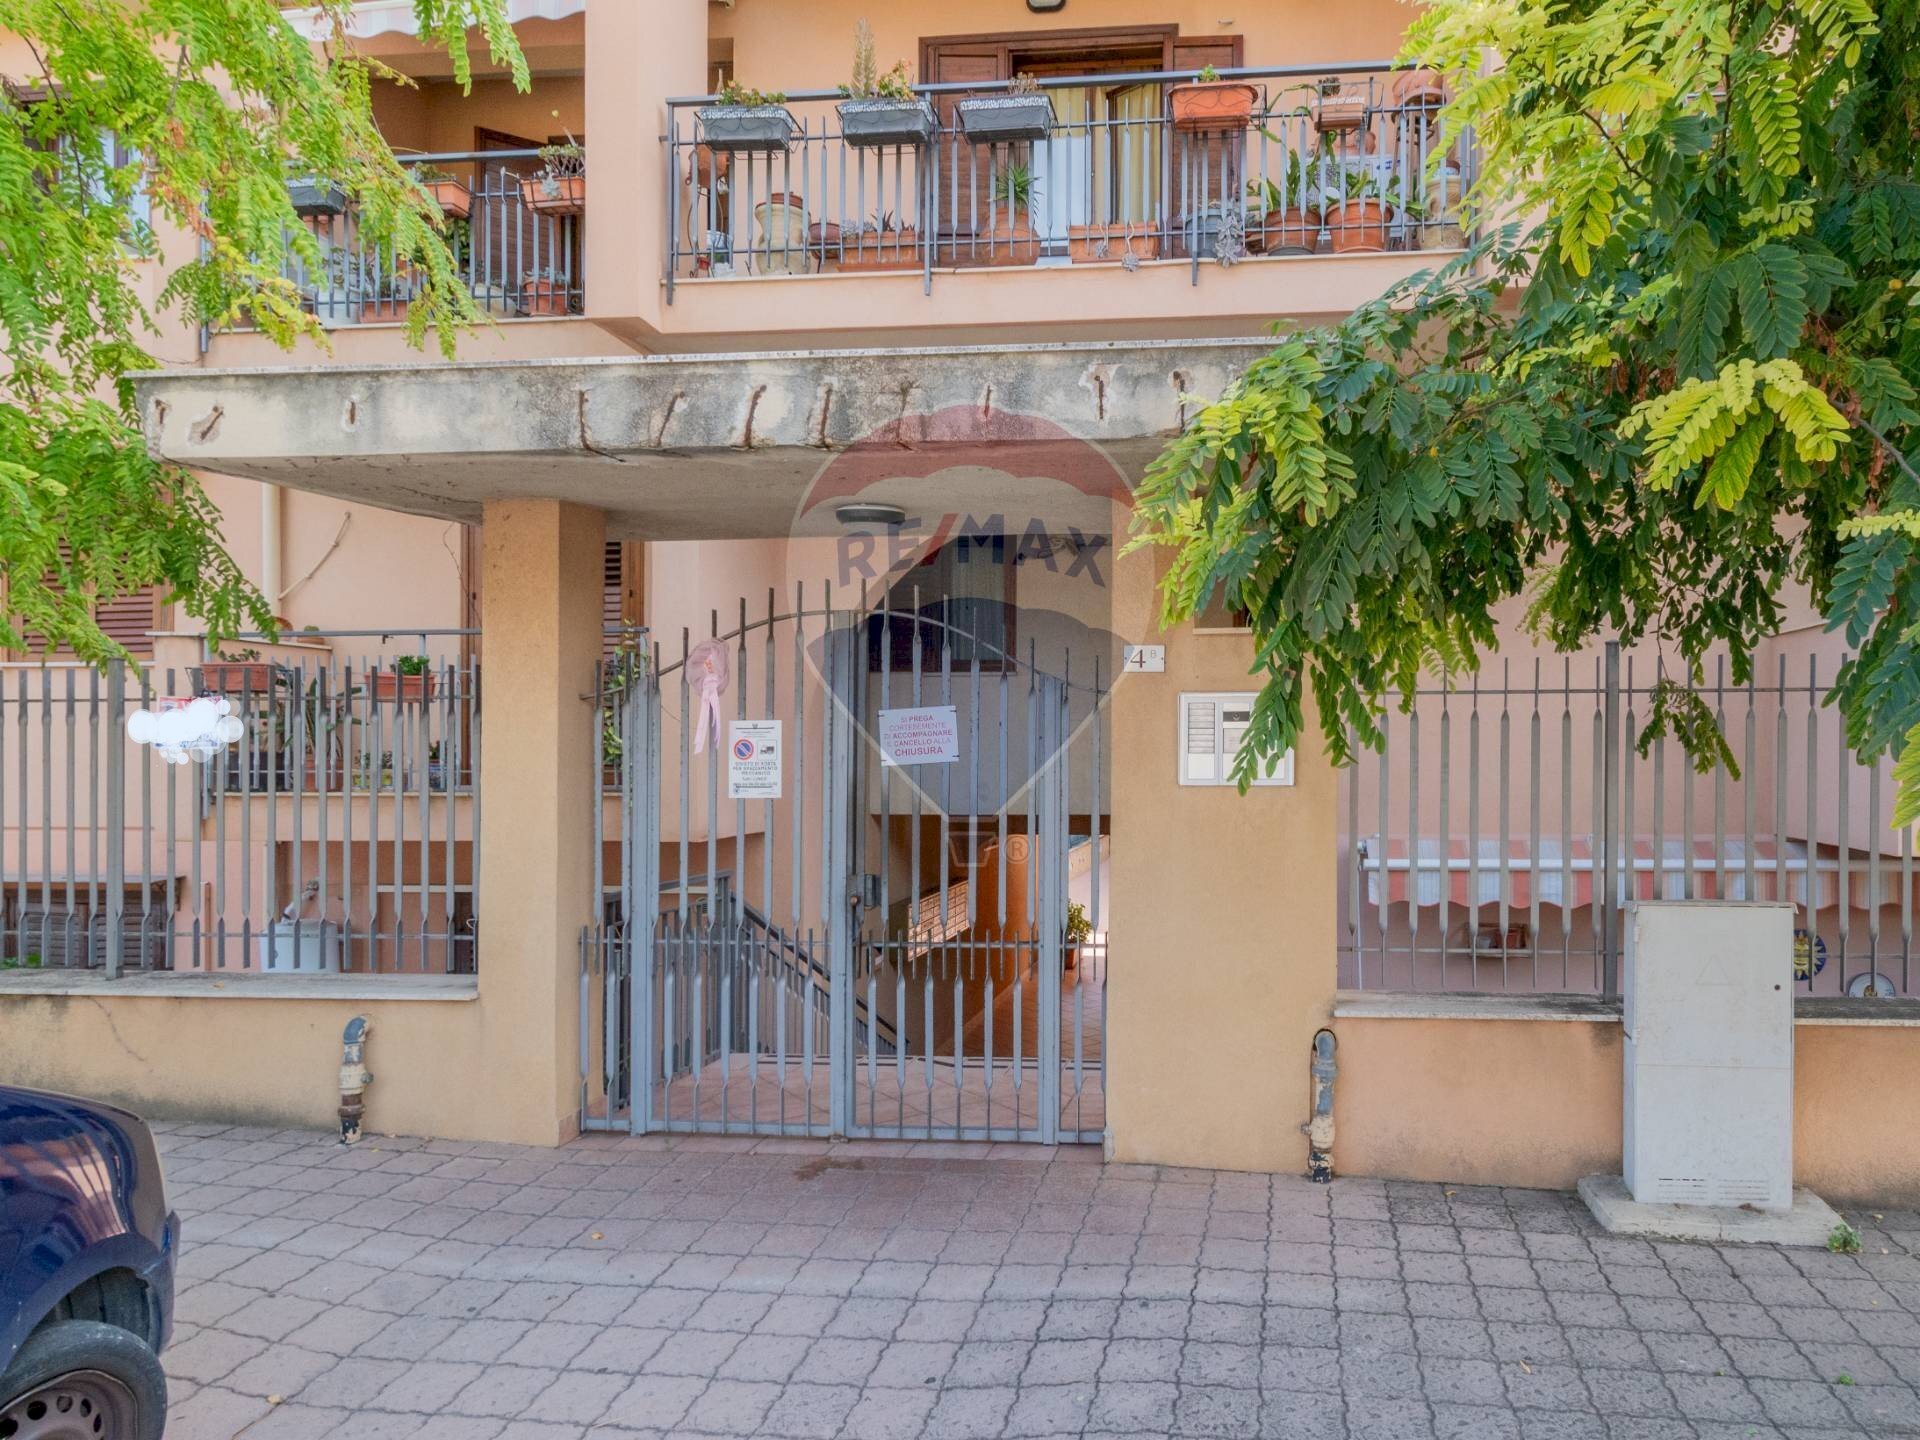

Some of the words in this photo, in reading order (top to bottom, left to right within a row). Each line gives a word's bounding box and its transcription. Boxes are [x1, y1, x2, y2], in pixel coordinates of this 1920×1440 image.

[1130, 649, 1146, 668] 4
[908, 714, 934, 722] PREGA
[889, 722, 946, 731] CORTESEMENTE
[893, 729, 953, 739] ACCOMPAGNARE
[895, 739, 933, 747] CANCELLO
[895, 746, 944, 757] CHIUSURA
